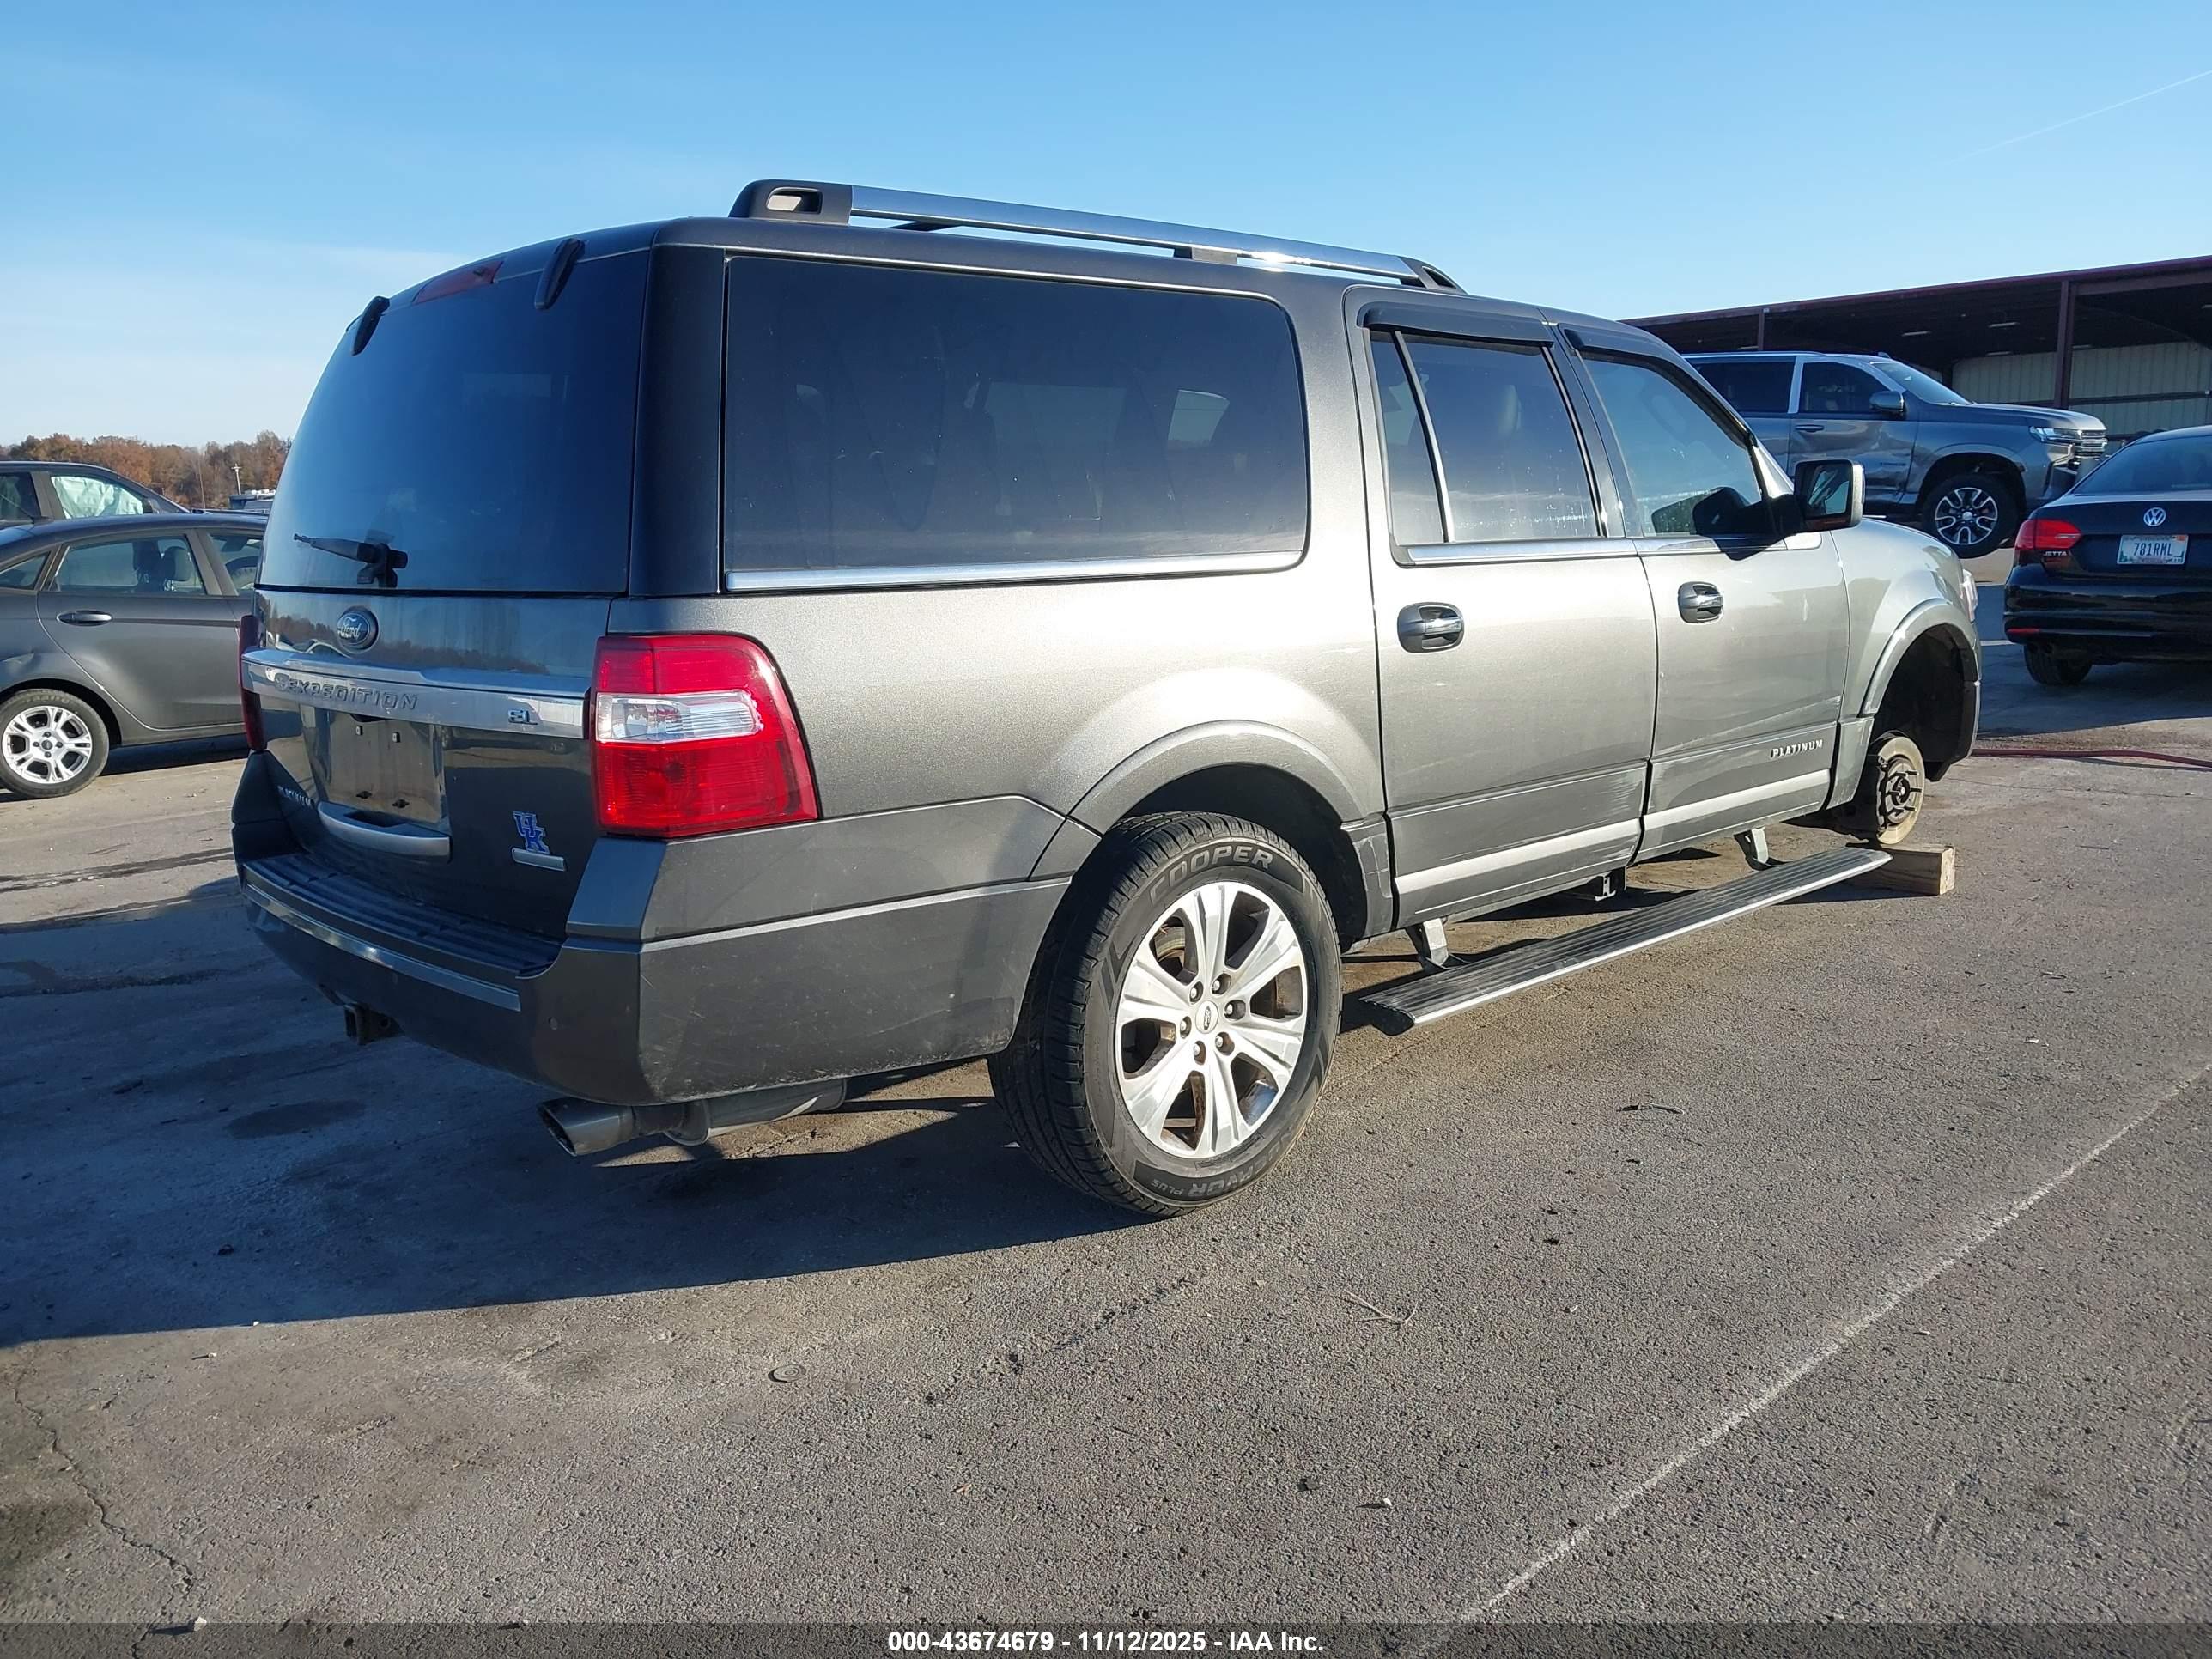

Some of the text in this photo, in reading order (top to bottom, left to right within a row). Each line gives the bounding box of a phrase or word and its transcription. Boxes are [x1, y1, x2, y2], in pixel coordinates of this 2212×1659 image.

[2133, 543, 2173, 556] 781RML
[288, 678, 419, 710] EXPEDITION
[1771, 738, 1823, 757] PLATINUM
[1150, 845, 1273, 906] COOPER
[1150, 1178, 1184, 1196] PLUS
